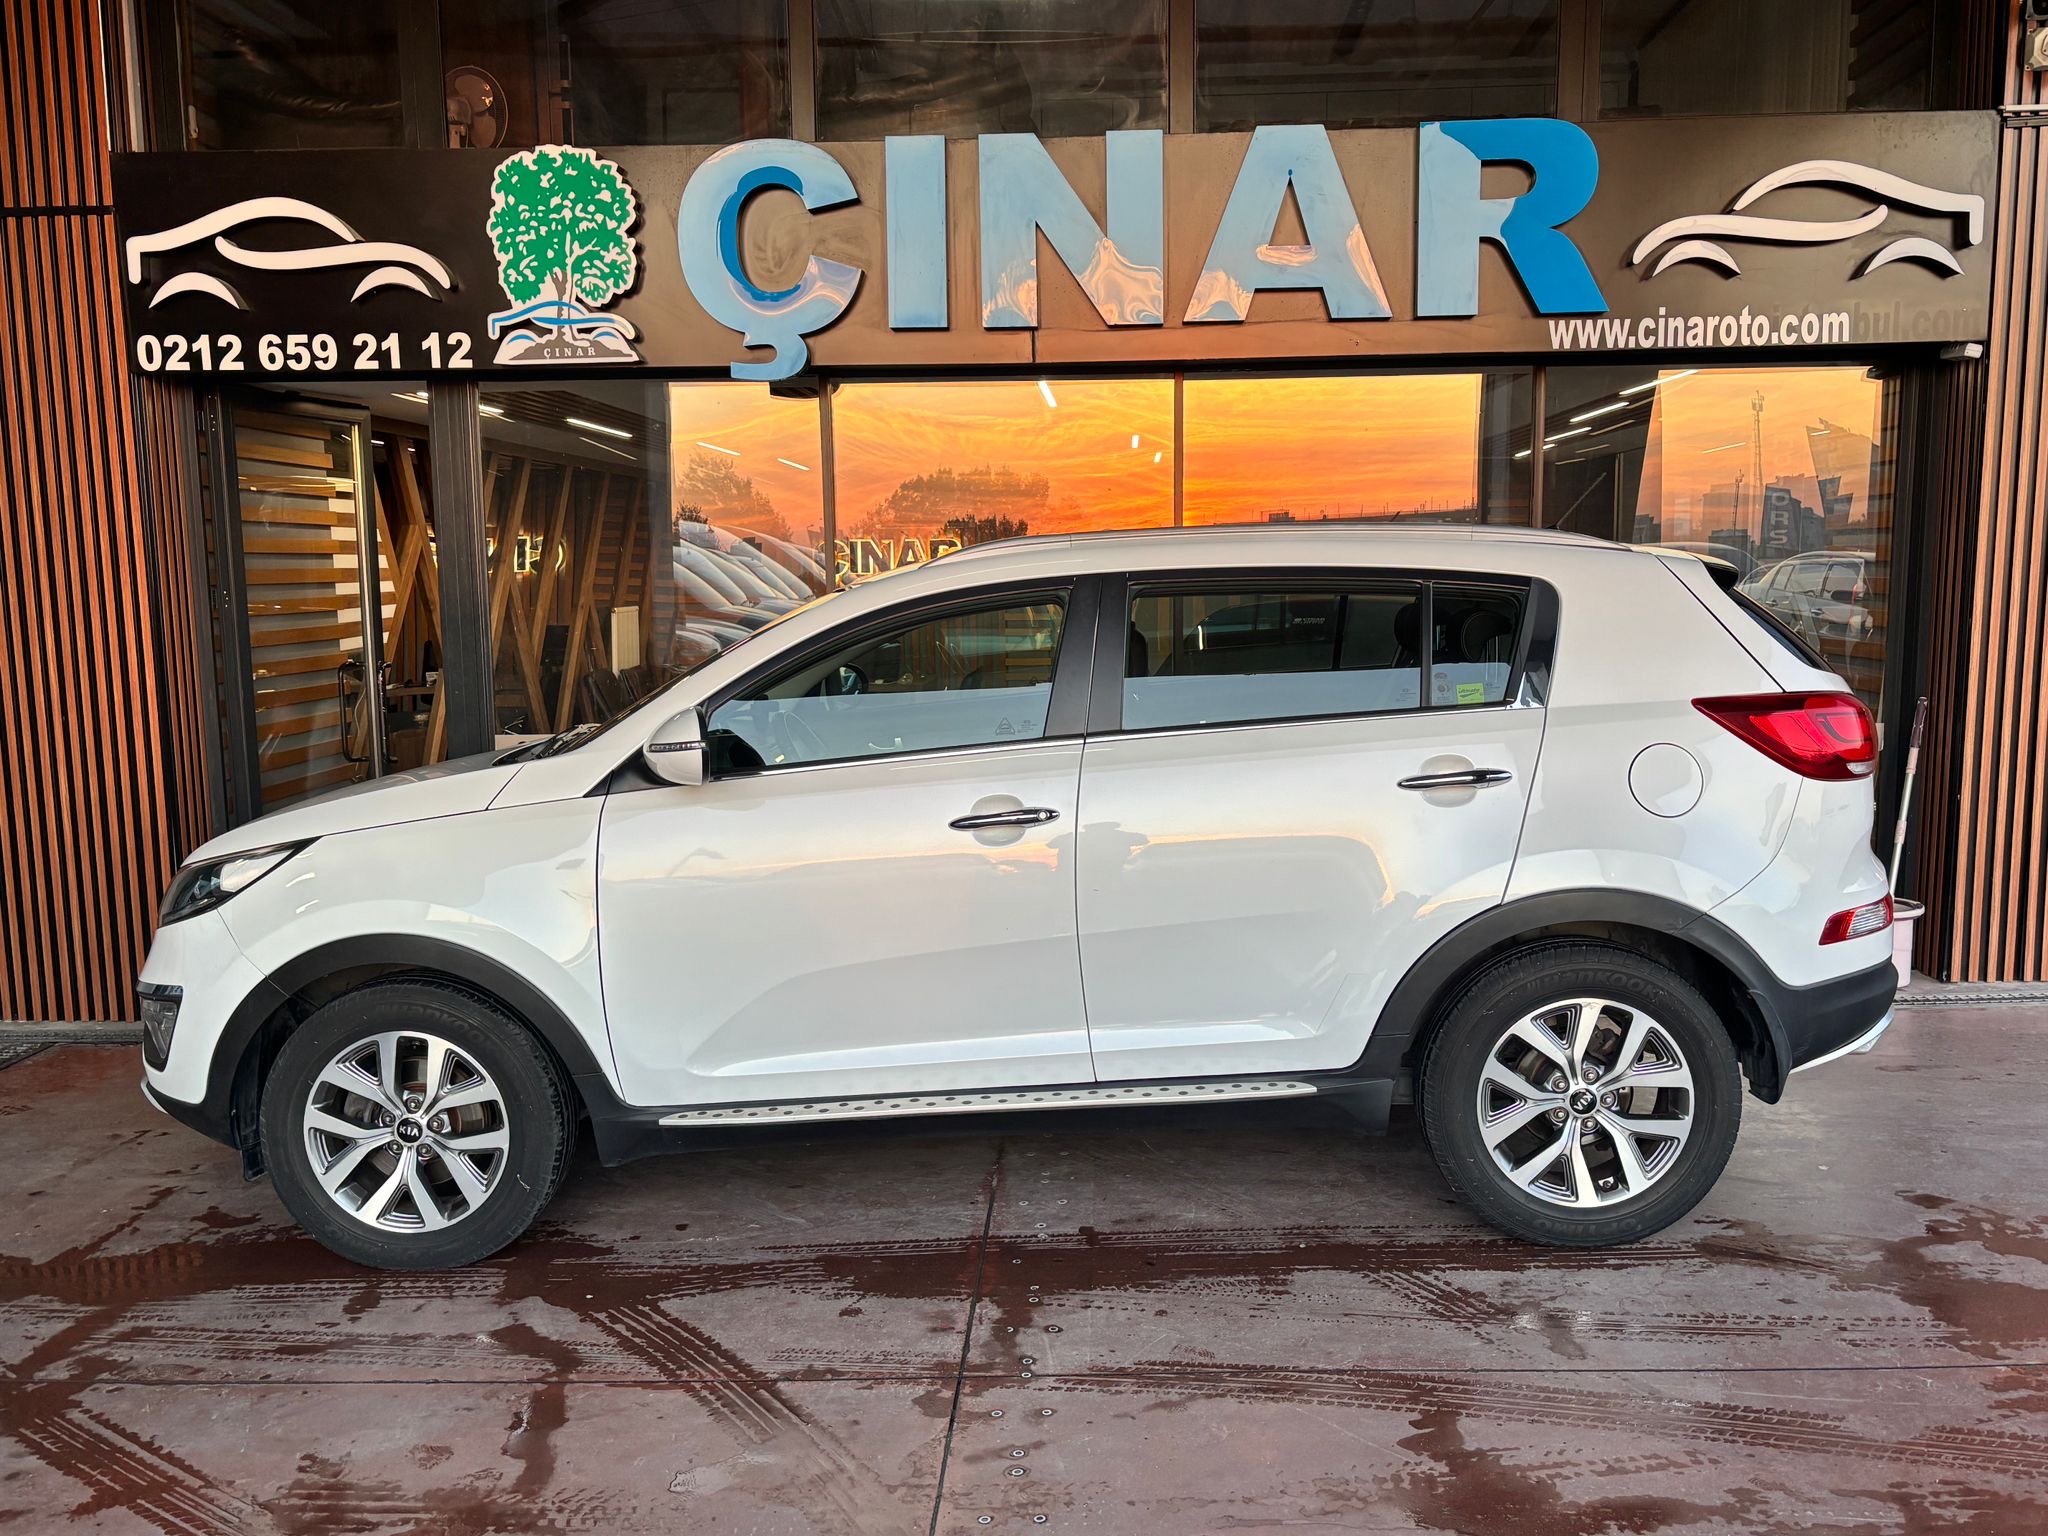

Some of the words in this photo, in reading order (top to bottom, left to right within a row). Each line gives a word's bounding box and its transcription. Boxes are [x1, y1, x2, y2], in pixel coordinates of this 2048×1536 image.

[677, 118, 1610, 380] ÇINAR
[1548, 305, 1850, 350] www.cinaroto.com
[136, 334, 245, 372] 0212
[258, 333, 338, 371] 659
[352, 332, 401, 370] 21
[421, 332, 474, 369] 12
[543, 346, 596, 359] ÇINAR
[399, 1125, 420, 1137] KIA
